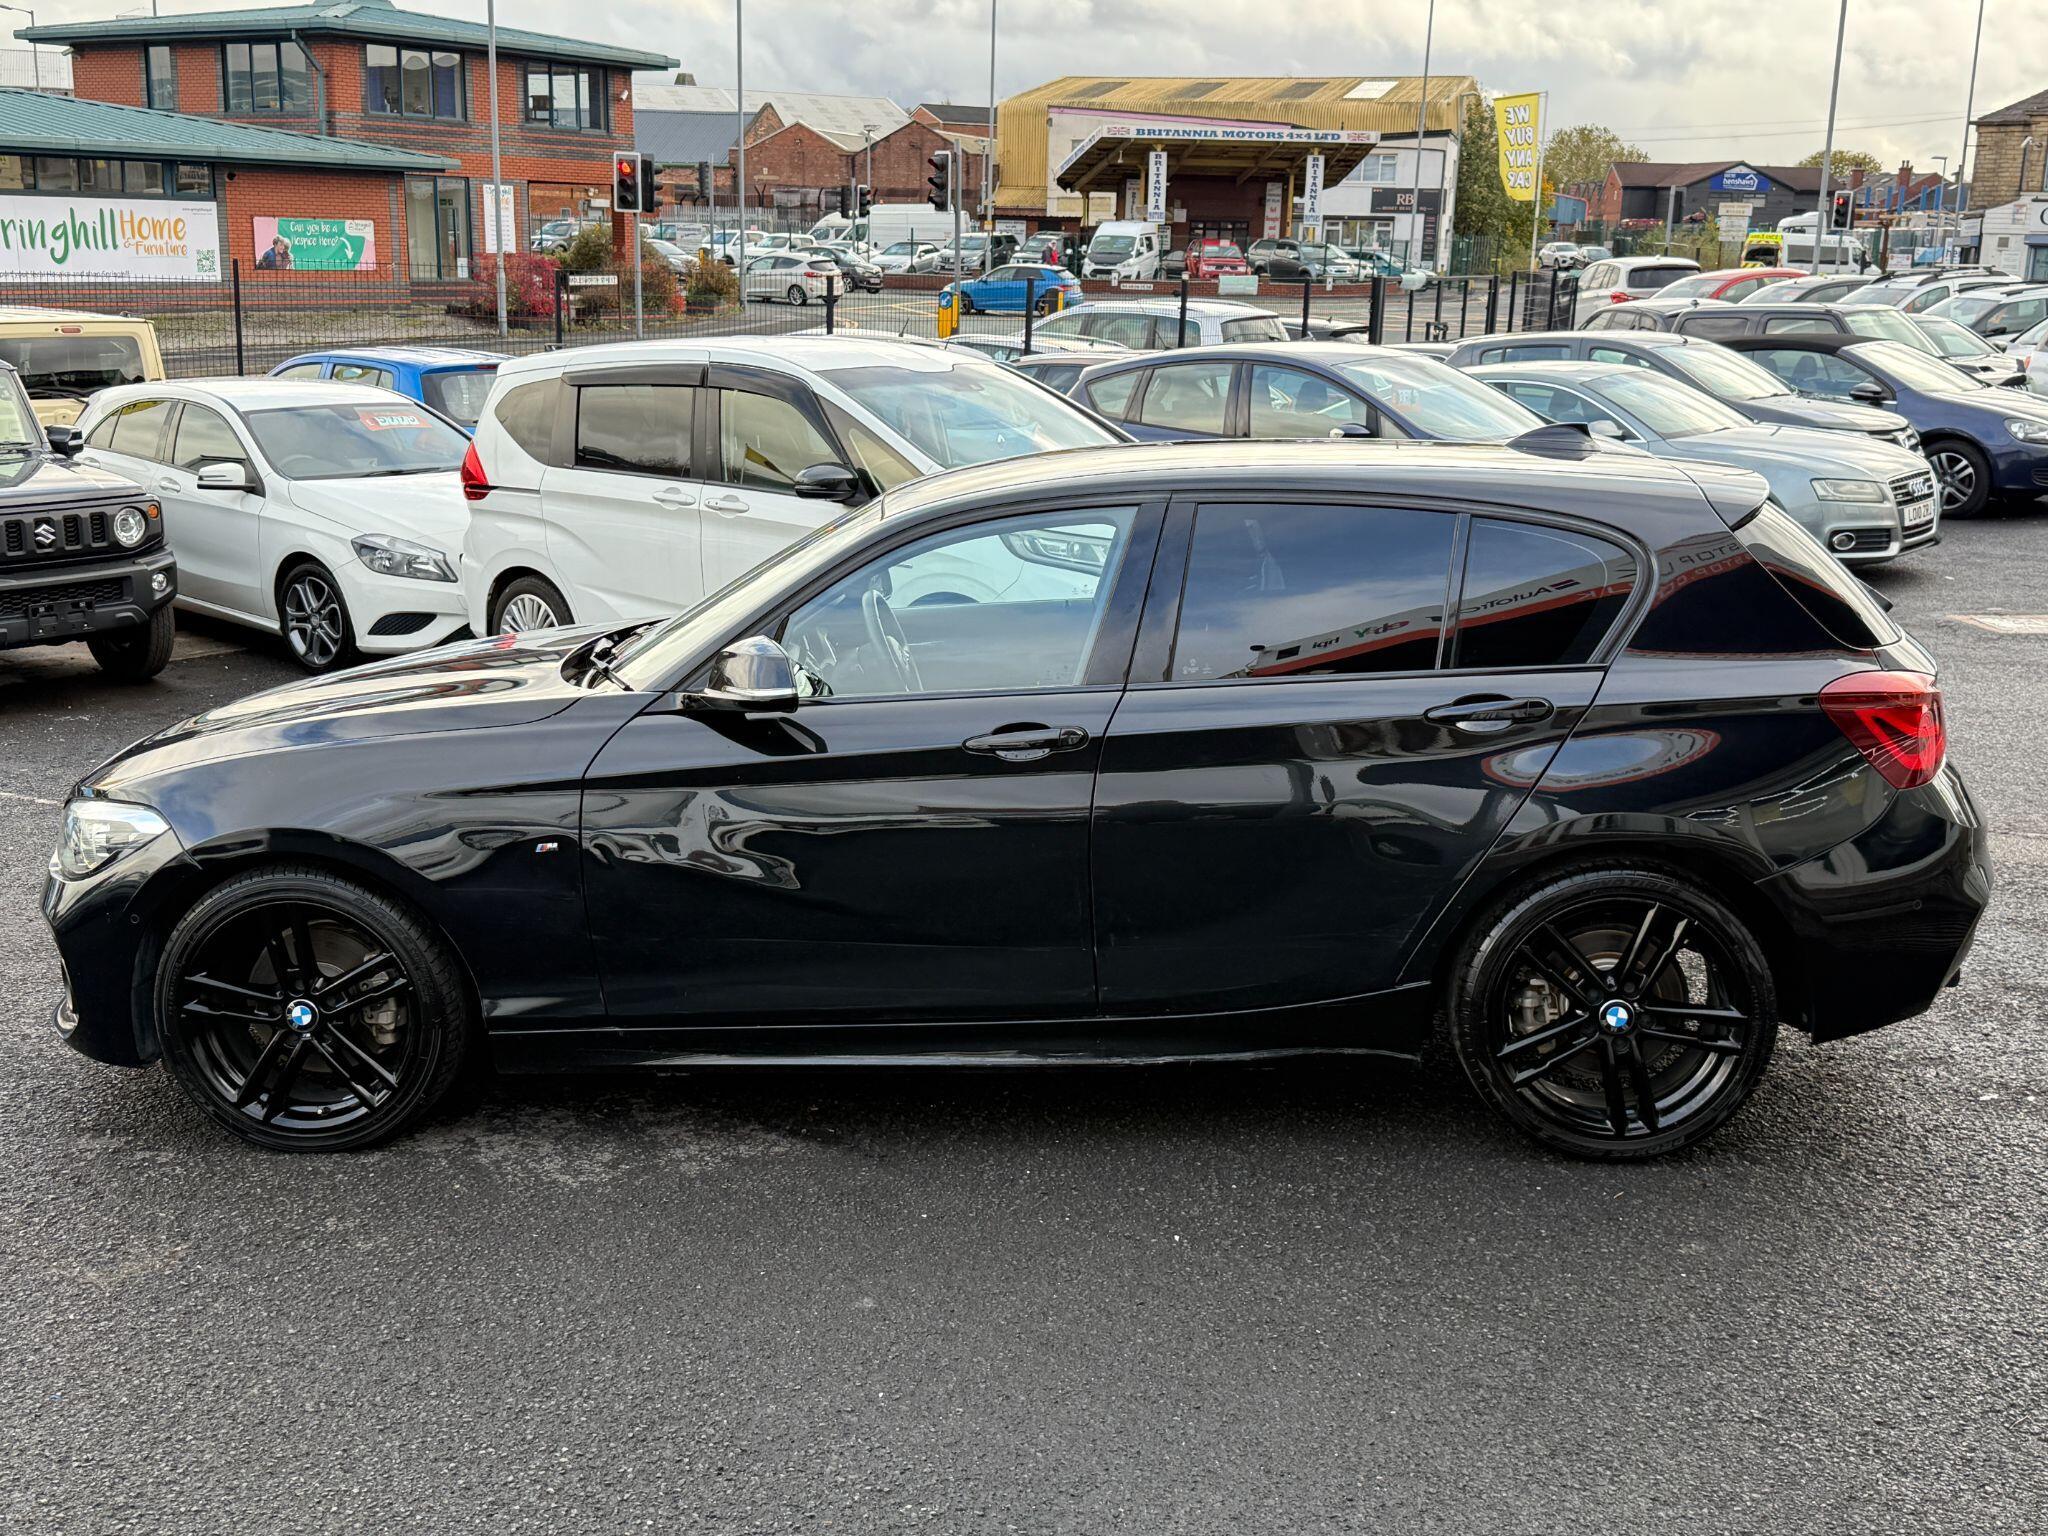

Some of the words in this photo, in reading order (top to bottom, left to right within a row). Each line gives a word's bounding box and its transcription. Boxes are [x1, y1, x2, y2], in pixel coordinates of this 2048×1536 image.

[1135, 127, 1218, 139] BRITANNIA
[1222, 129, 1284, 140] MOTORS
[1314, 132, 1341, 141] LTD
[1153, 153, 1162, 211] BRITANNIA
[1308, 156, 1320, 213] BRITANNIA
[1396, 193, 1414, 206] RB
[119, 208, 187, 241] Home
[290, 222, 305, 232] Can
[306, 223, 321, 236] you
[321, 222, 331, 233] be
[135, 240, 188, 257] Furniture
